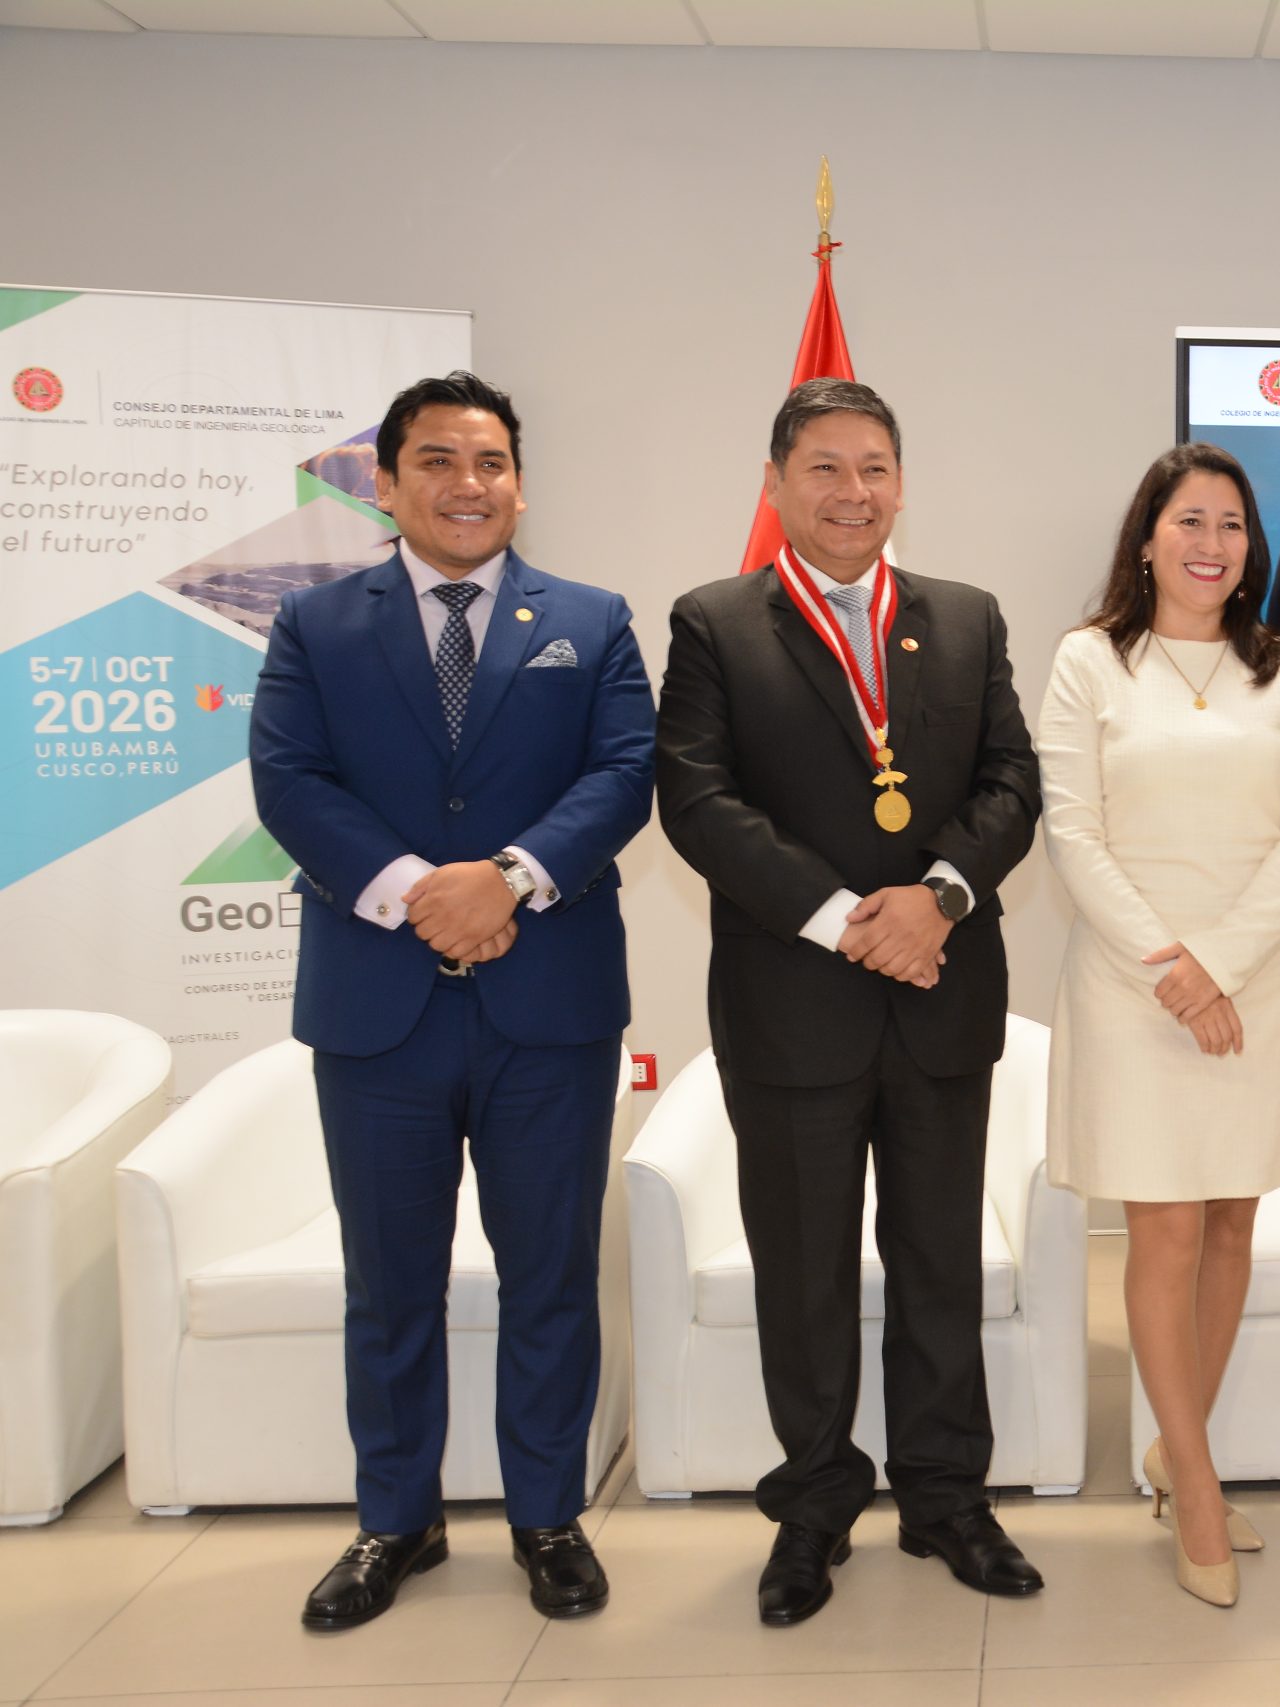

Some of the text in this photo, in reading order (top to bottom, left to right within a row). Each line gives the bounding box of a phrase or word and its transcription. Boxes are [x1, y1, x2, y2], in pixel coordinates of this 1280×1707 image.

[113, 401, 345, 420] CONSEJO DEPARTAMENTAL DE LIMA
[113, 416, 173, 429] CAPÍTULO
[175, 420, 192, 430] DE
[194, 420, 258, 432] INGENIERÍA
[0, 500, 209, 527] construyendo
[2, 530, 29, 552] el
[29, 656, 175, 683] 5-7 OCT
[32, 688, 178, 734] 2026
[34, 740, 178, 758] URUBAMBA
[184, 982, 250, 995] CONGRESO
[253, 982, 268, 991] DE
[247, 994, 254, 1003] Y
